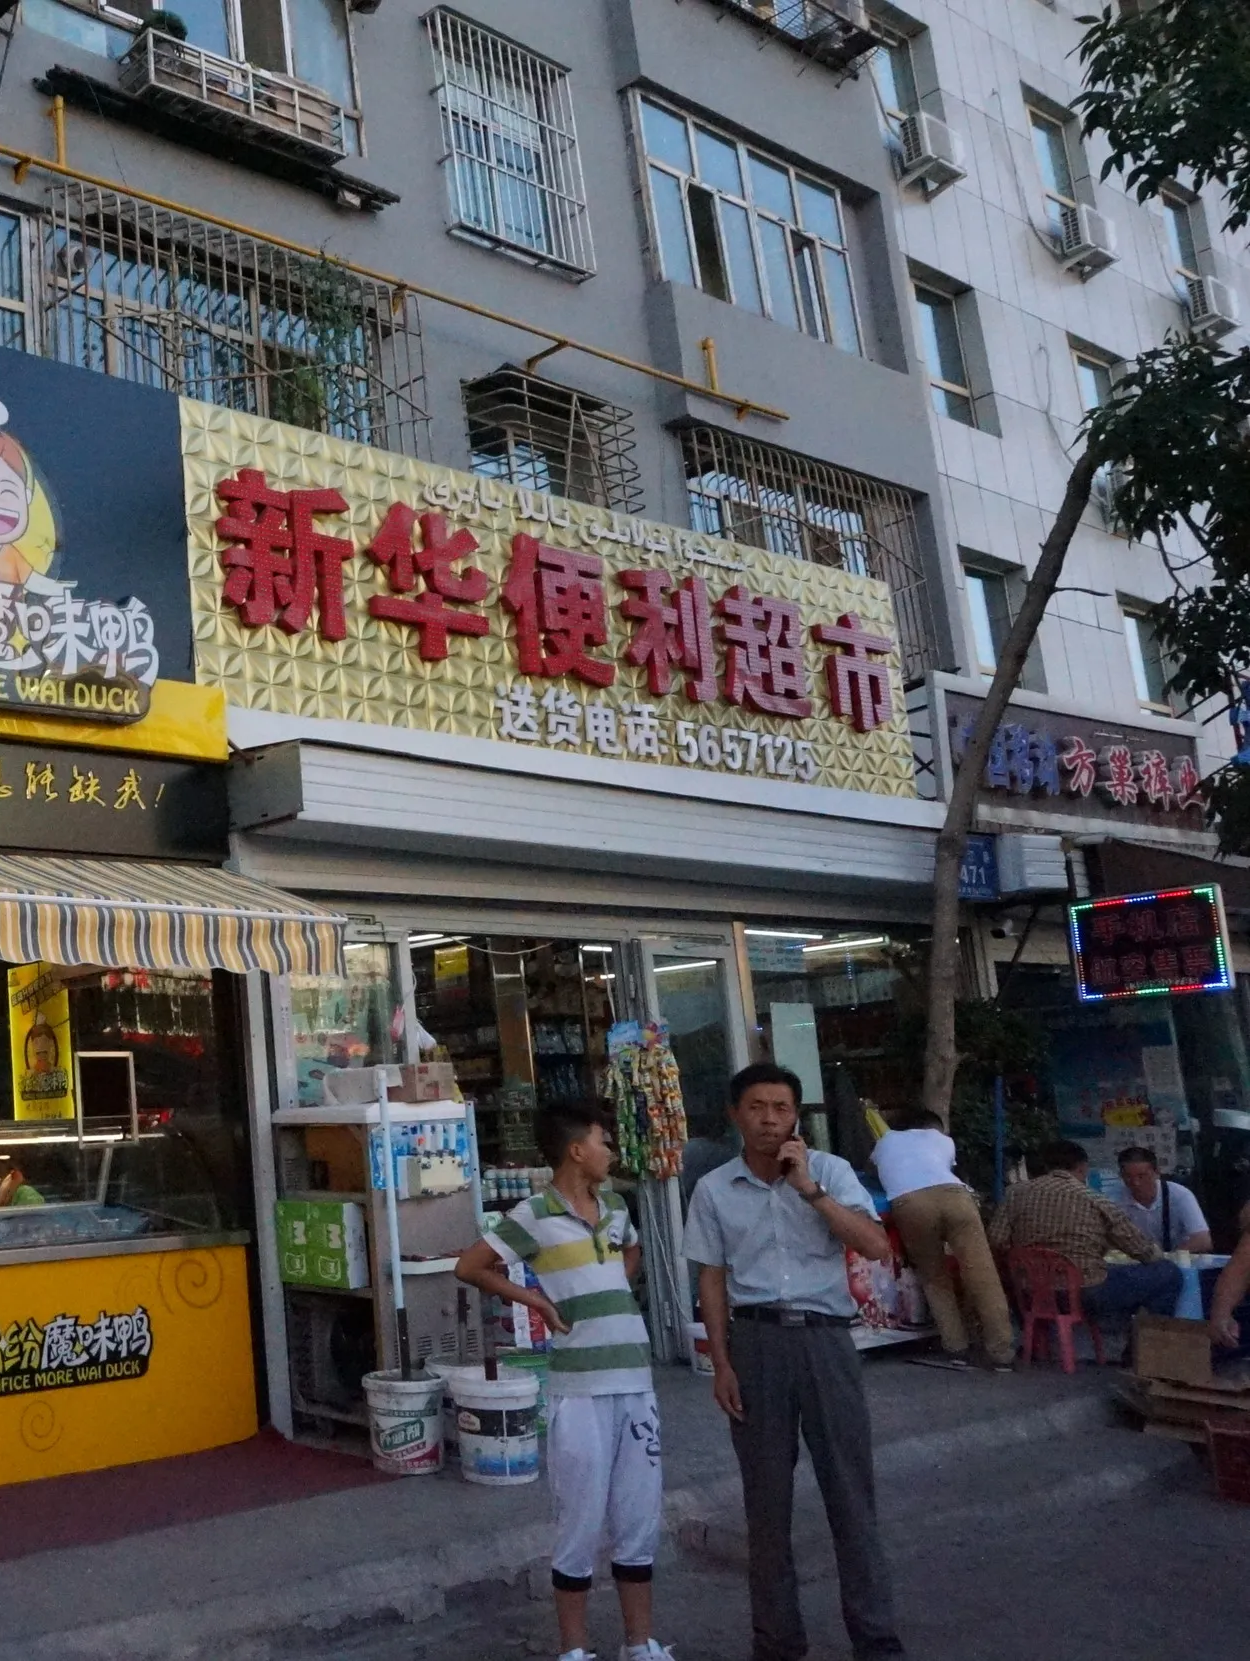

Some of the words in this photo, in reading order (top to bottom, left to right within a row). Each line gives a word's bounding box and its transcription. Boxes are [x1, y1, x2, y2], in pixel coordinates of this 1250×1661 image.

[216, 467, 897, 733] 新华便利超市
[16, 675, 66, 707] WAI
[73, 682, 141, 715] DUCK
[676, 719, 818, 781] 5657125
[35, 1369, 74, 1389] MORE
[76, 1365, 103, 1384] WAI
[106, 1360, 141, 1379] DUCK
